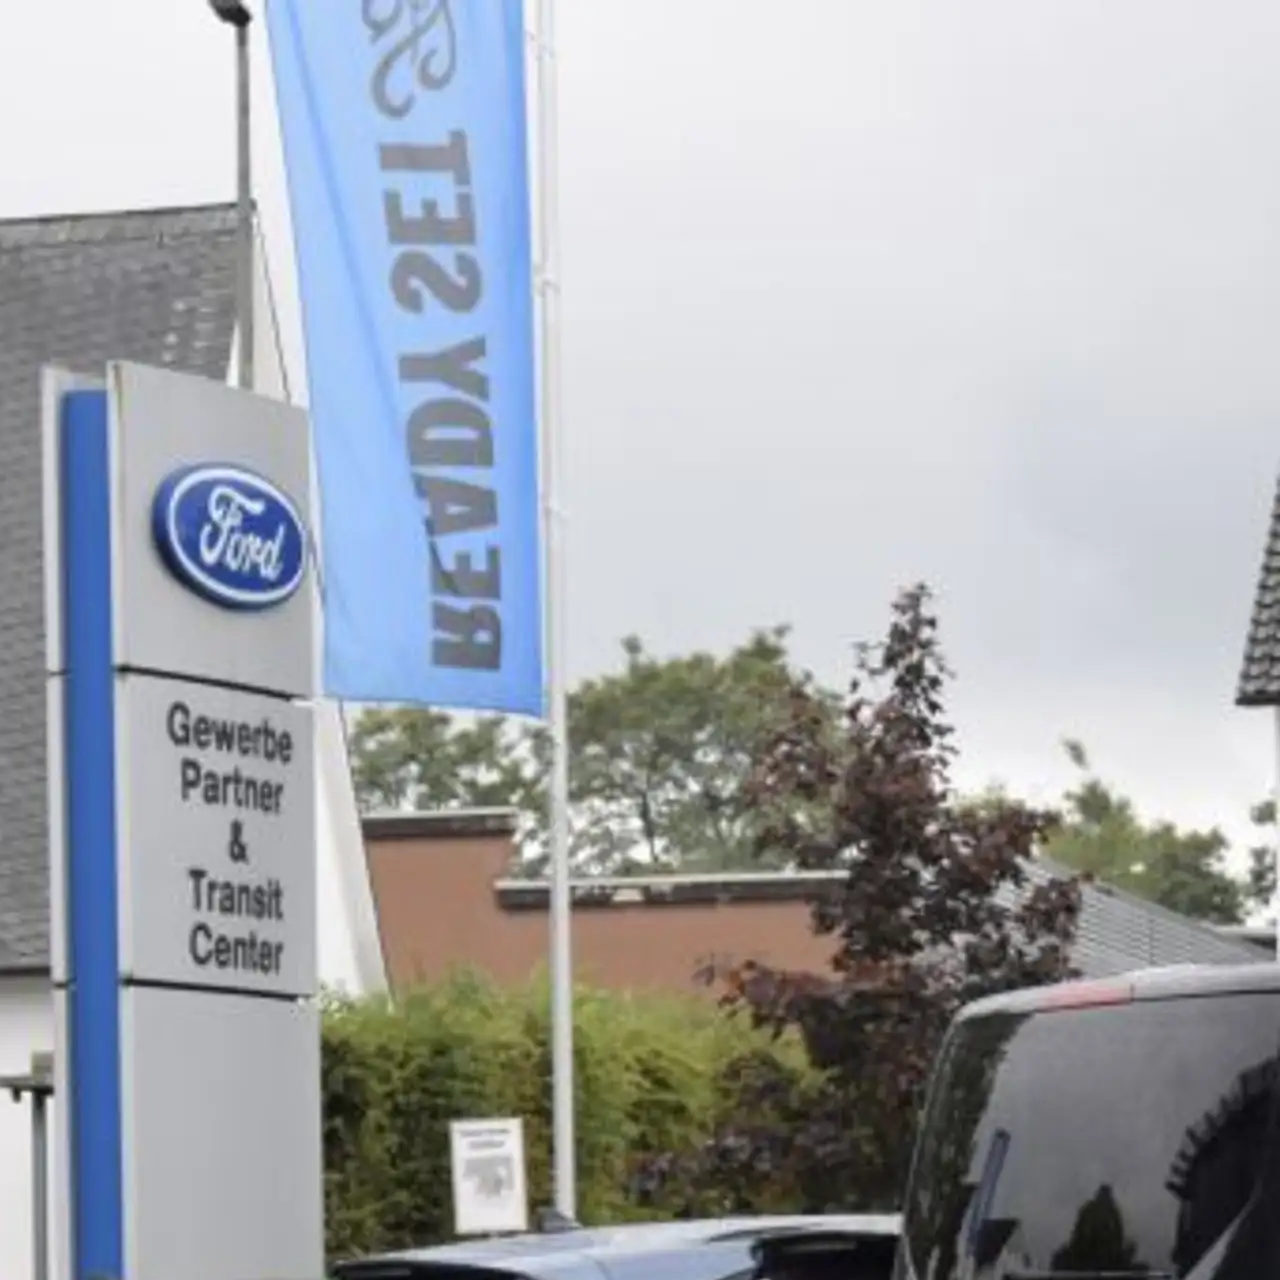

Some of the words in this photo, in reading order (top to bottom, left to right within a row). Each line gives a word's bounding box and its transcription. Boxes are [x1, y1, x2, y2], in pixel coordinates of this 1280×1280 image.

[199, 484, 286, 582] Ford
[167, 701, 293, 764] Gewerbe
[180, 757, 284, 815] Partner
[228, 818, 249, 865] &
[188, 868, 283, 921] Transit
[189, 921, 284, 975] Center
